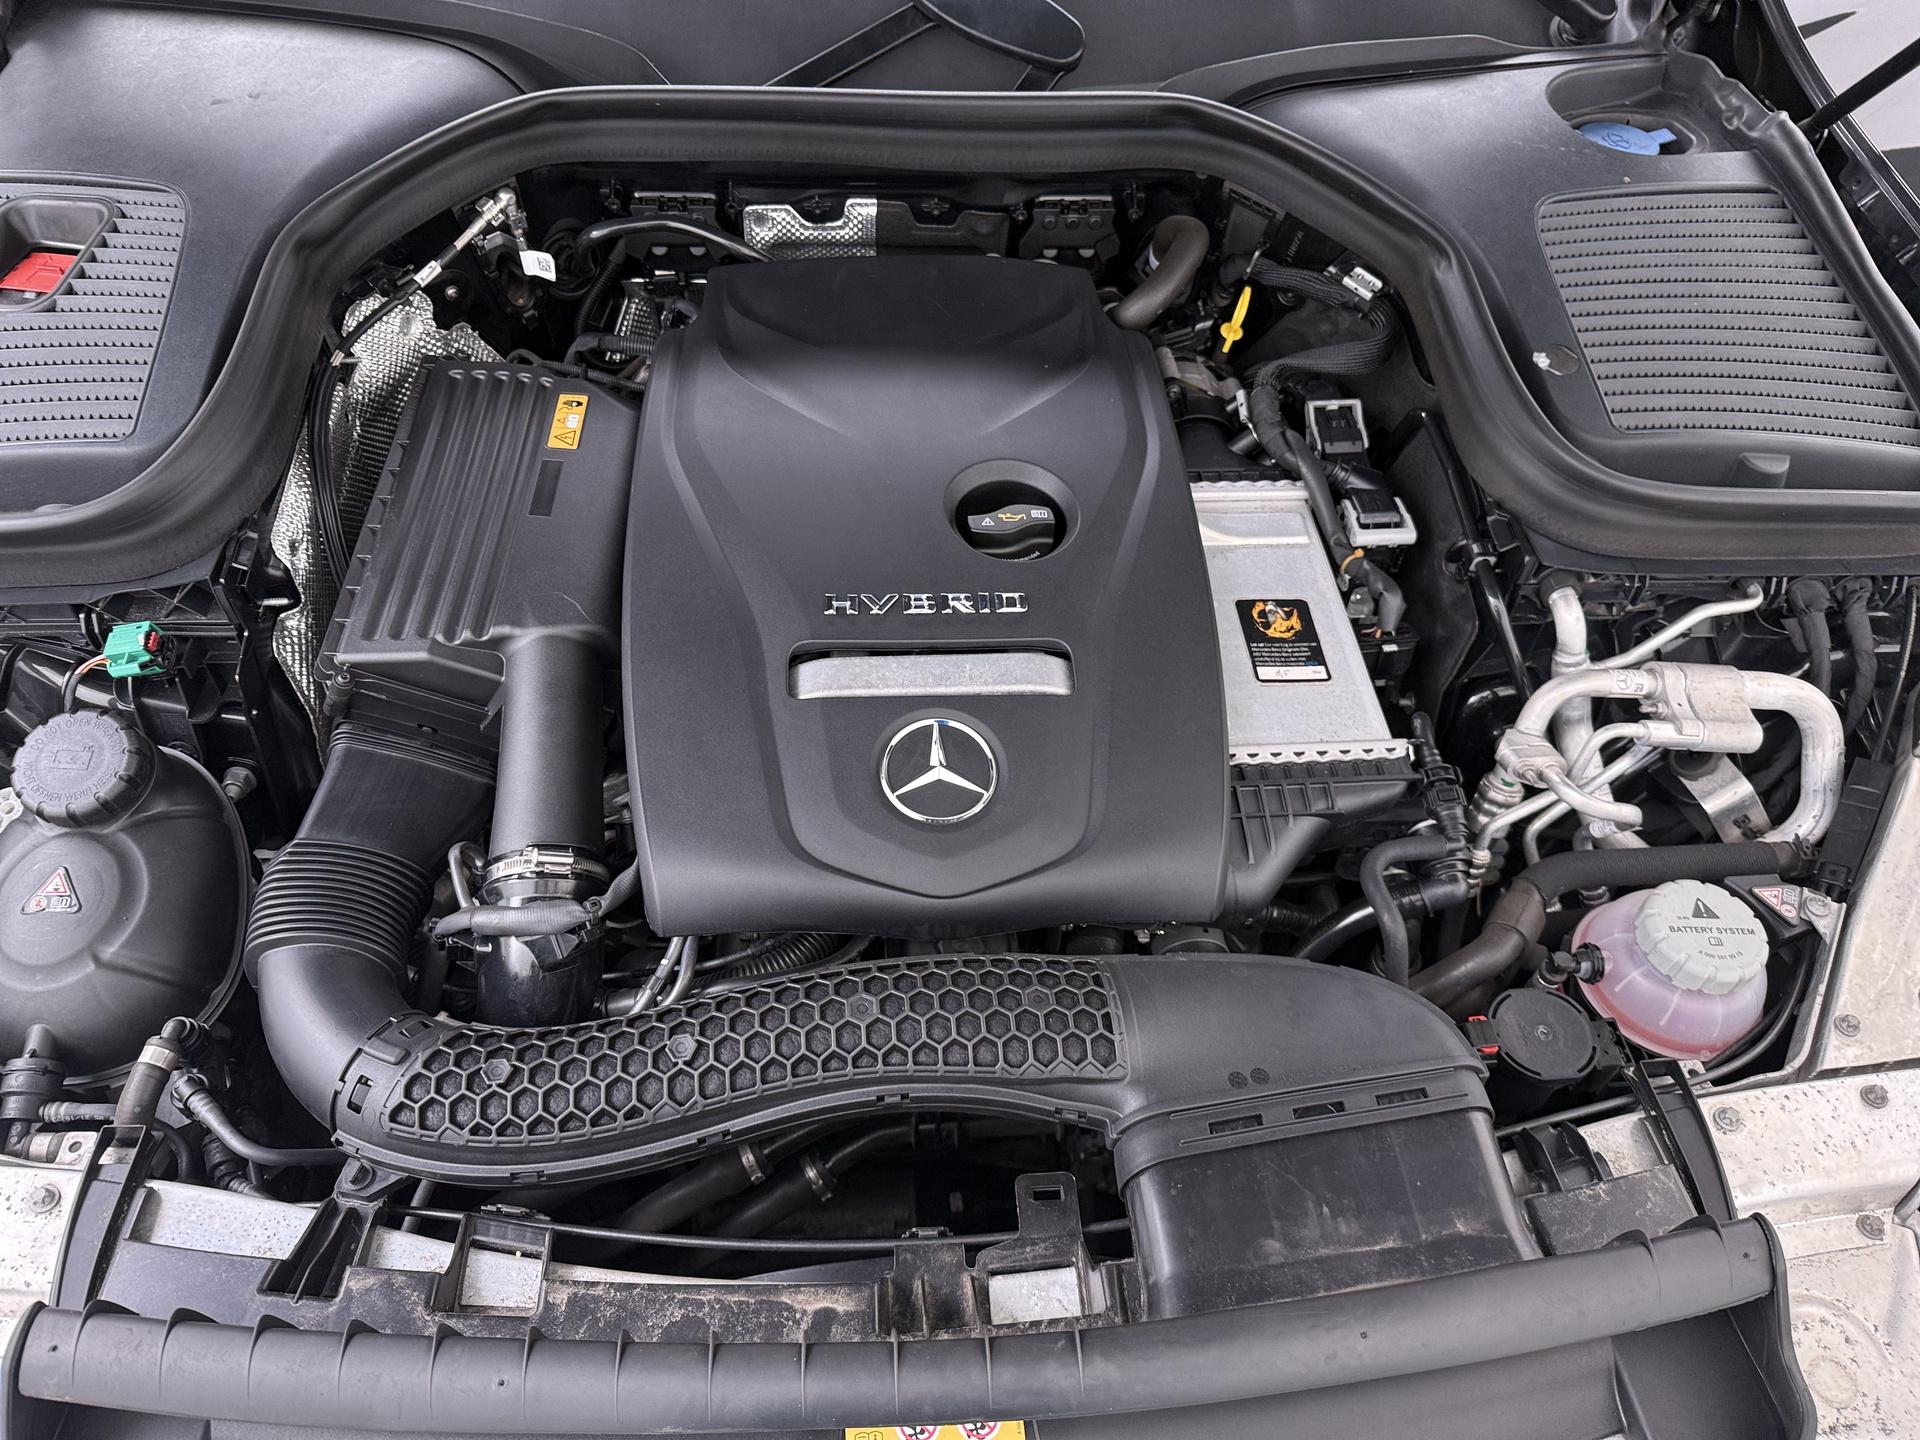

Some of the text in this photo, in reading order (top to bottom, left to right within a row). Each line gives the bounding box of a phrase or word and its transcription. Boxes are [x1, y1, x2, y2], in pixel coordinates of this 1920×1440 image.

[824, 592, 1028, 614] HYBRID
[65, 719, 92, 729] OPEN
[1668, 925, 1756, 936] BATTERY SYSTEM
